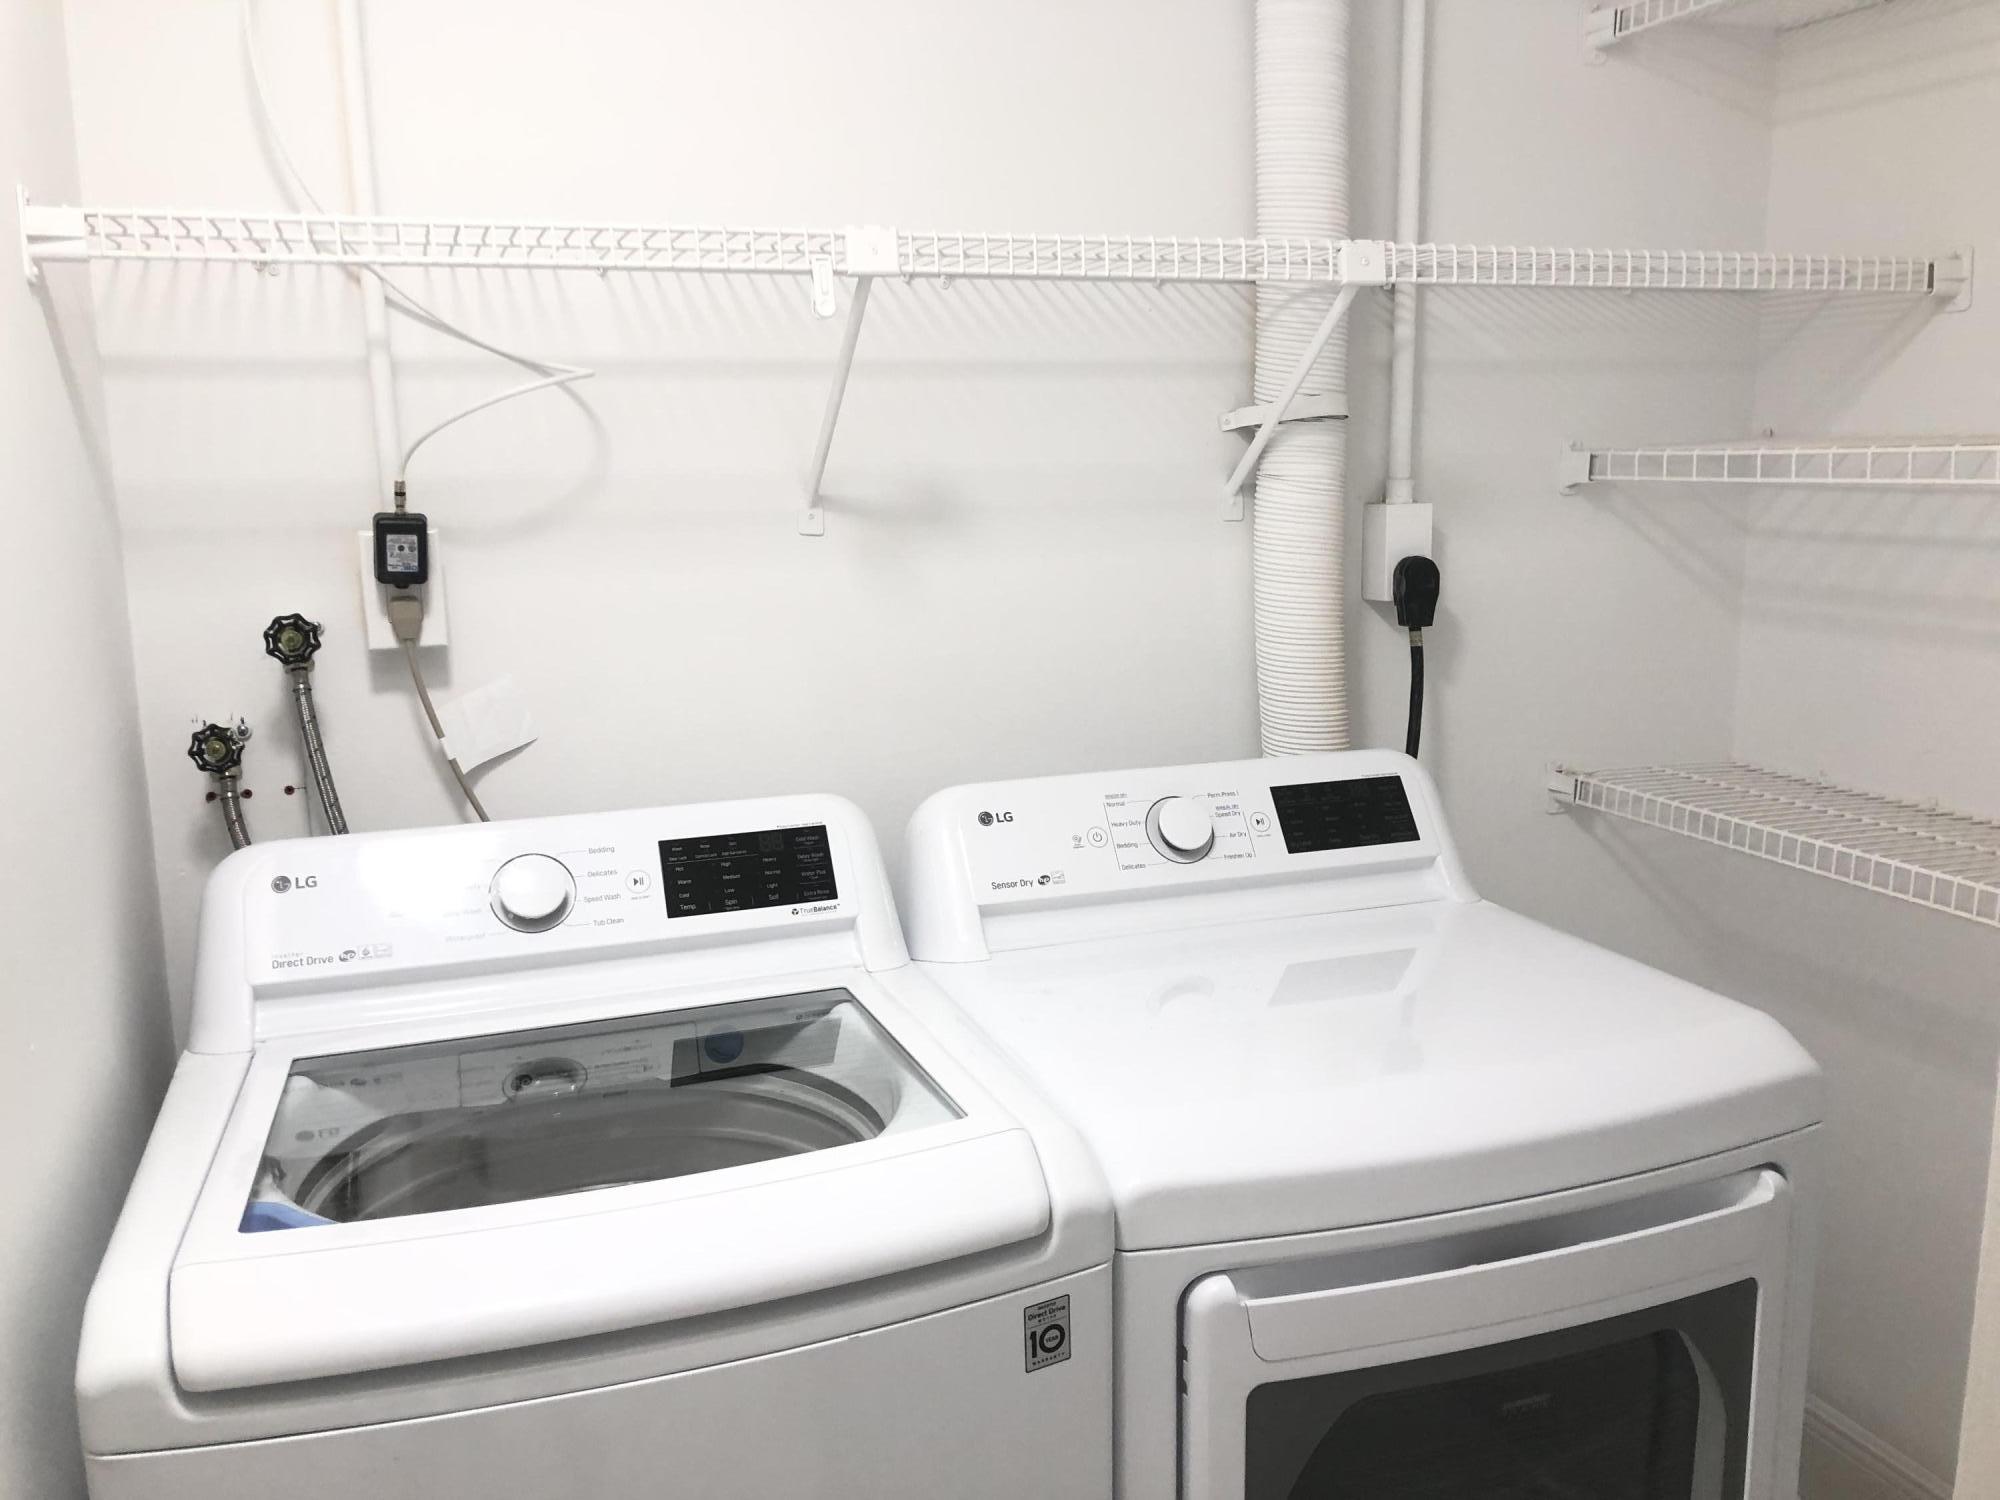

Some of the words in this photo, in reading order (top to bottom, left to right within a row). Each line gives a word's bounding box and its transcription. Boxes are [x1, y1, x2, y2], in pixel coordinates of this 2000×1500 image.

[996, 811, 1014, 823] LG
[588, 846, 615, 855] Bedding
[1121, 863, 1146, 871] Delicates
[587, 869, 618, 878] Delicates
[295, 875, 318, 889] LG
[991, 881, 1019, 890] Sensor
[1019, 879, 1034, 889] Dry
[602, 893, 621, 901] Wash
[593, 919, 606, 927] Tub
[606, 917, 625, 925] Clean
[272, 958, 304, 969] Direct
[306, 955, 334, 966] Drive
[1027, 1310, 1048, 1321] Direct
[1048, 1305, 1066, 1315] Drive
[1029, 1323, 1066, 1359] 10
